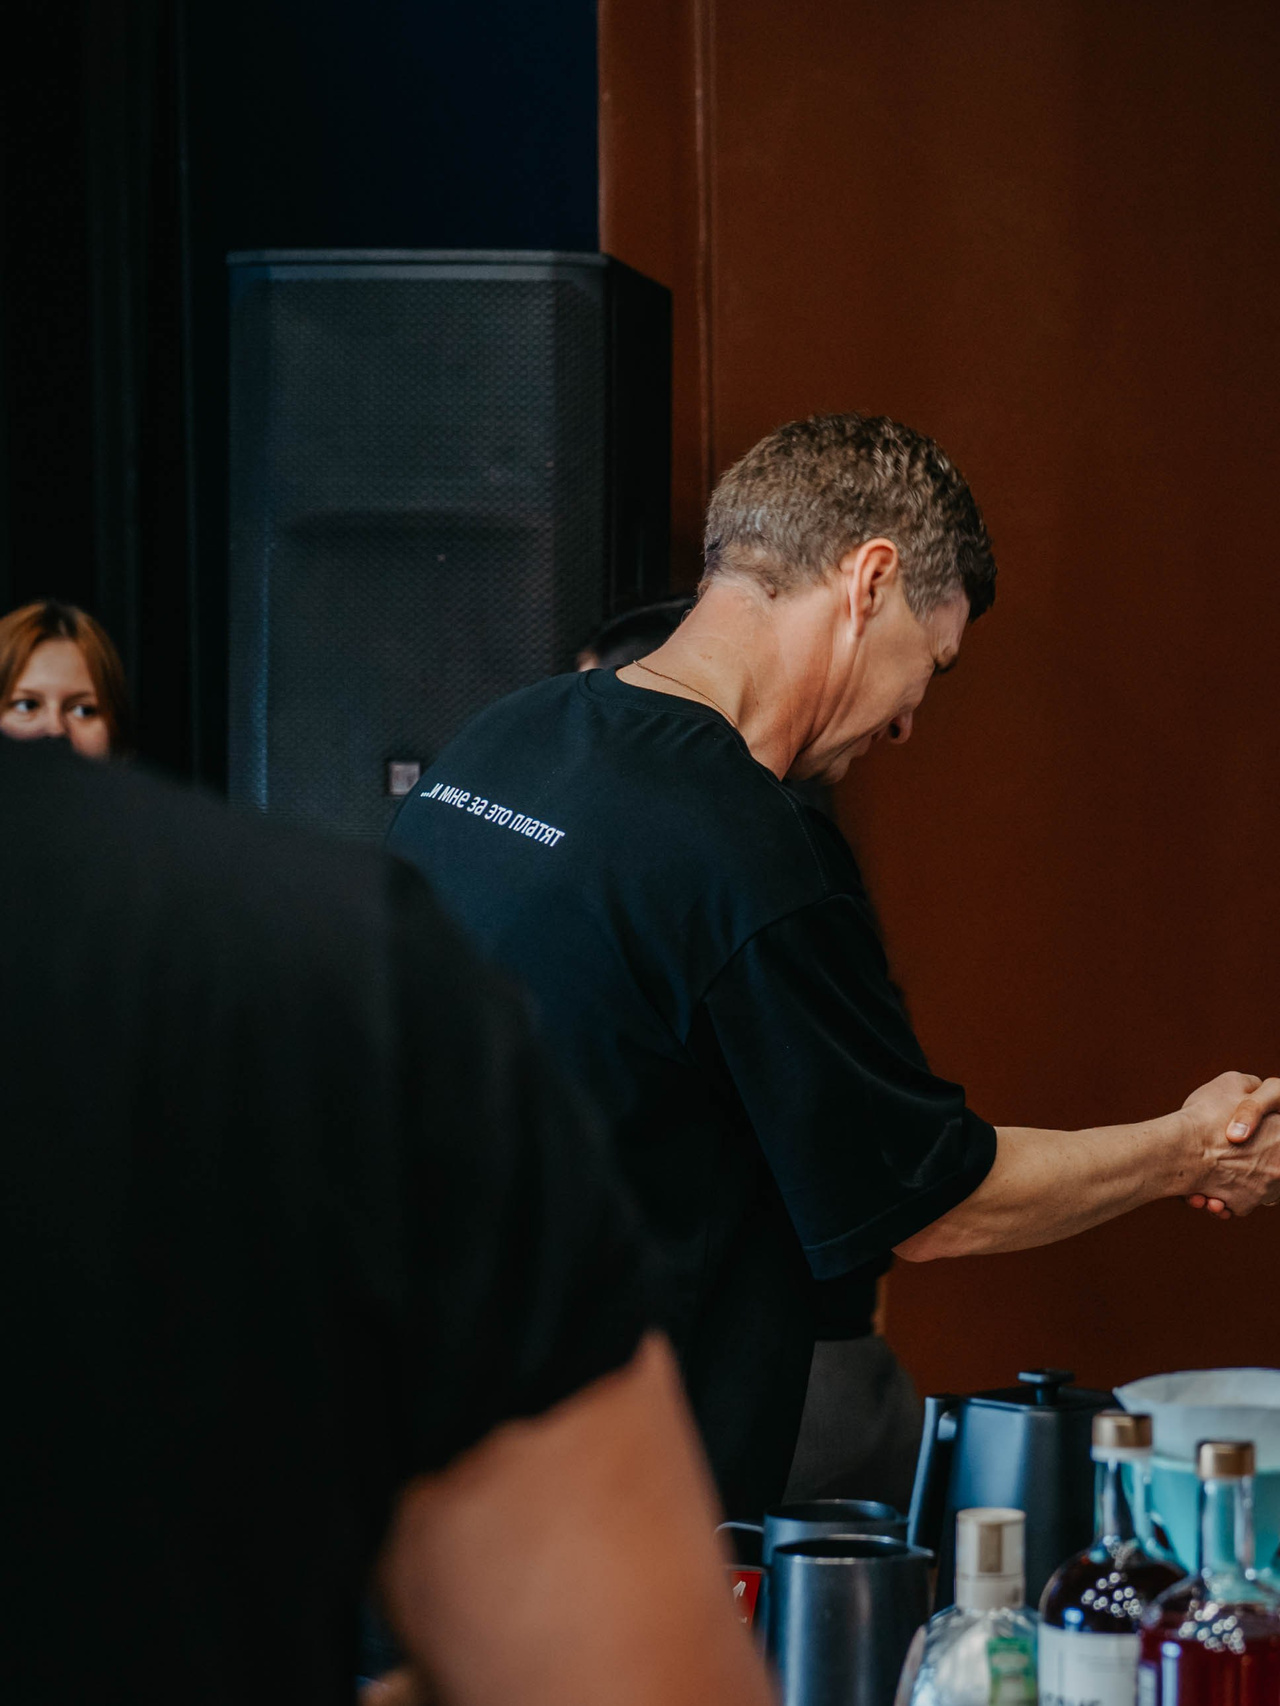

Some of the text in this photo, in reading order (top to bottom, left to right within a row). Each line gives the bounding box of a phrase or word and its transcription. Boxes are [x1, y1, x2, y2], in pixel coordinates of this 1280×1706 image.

[437, 785, 471, 808] мне
[466, 796, 489, 816] за
[484, 804, 513, 826] это
[508, 813, 566, 847] платят
